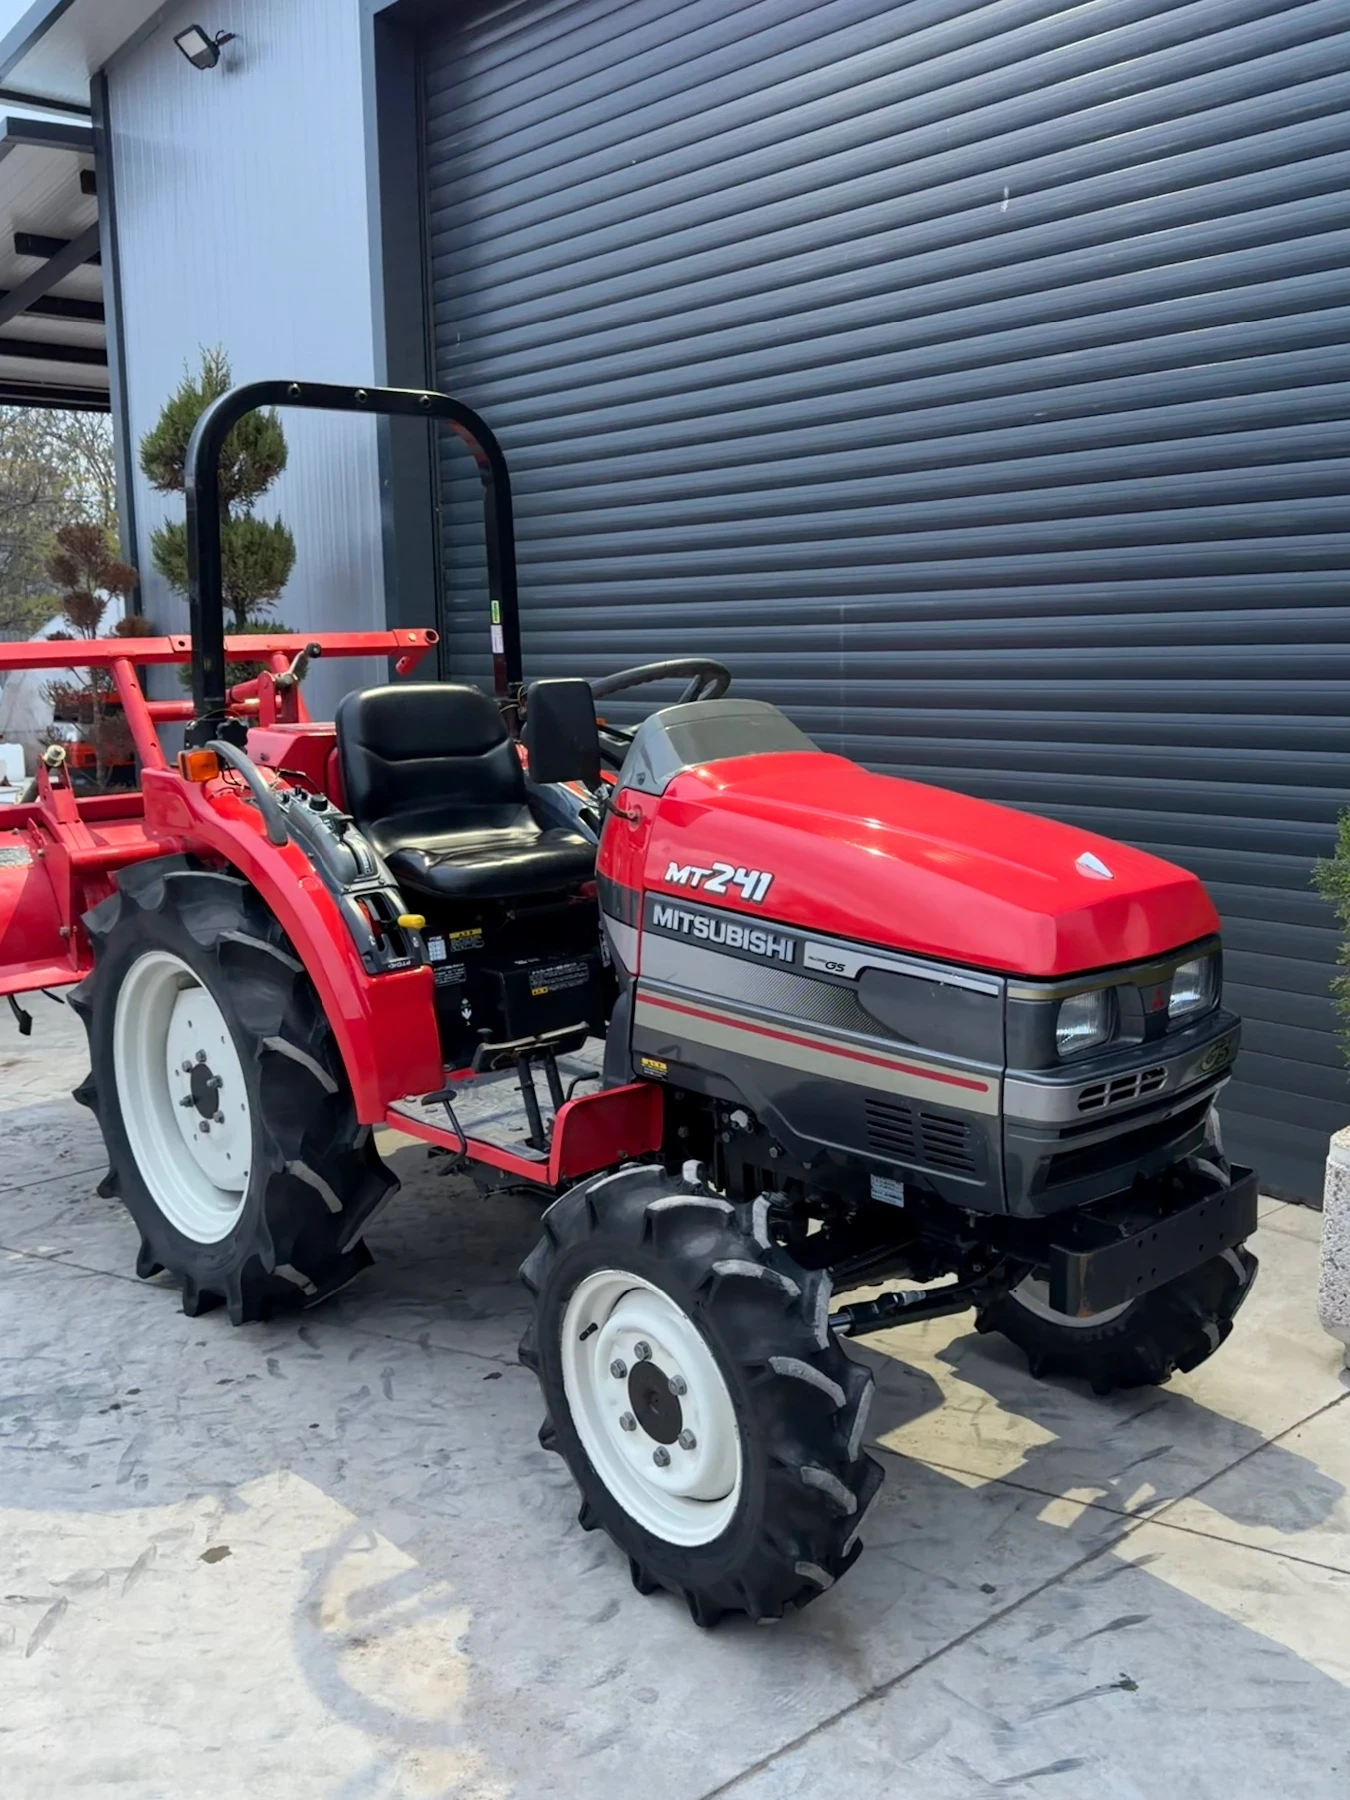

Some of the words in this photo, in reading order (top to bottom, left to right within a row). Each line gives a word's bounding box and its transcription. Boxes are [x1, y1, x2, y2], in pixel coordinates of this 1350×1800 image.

[664, 861, 774, 904] MT241
[652, 904, 795, 963] MITSUBISHI
[825, 961, 846, 973] GS
